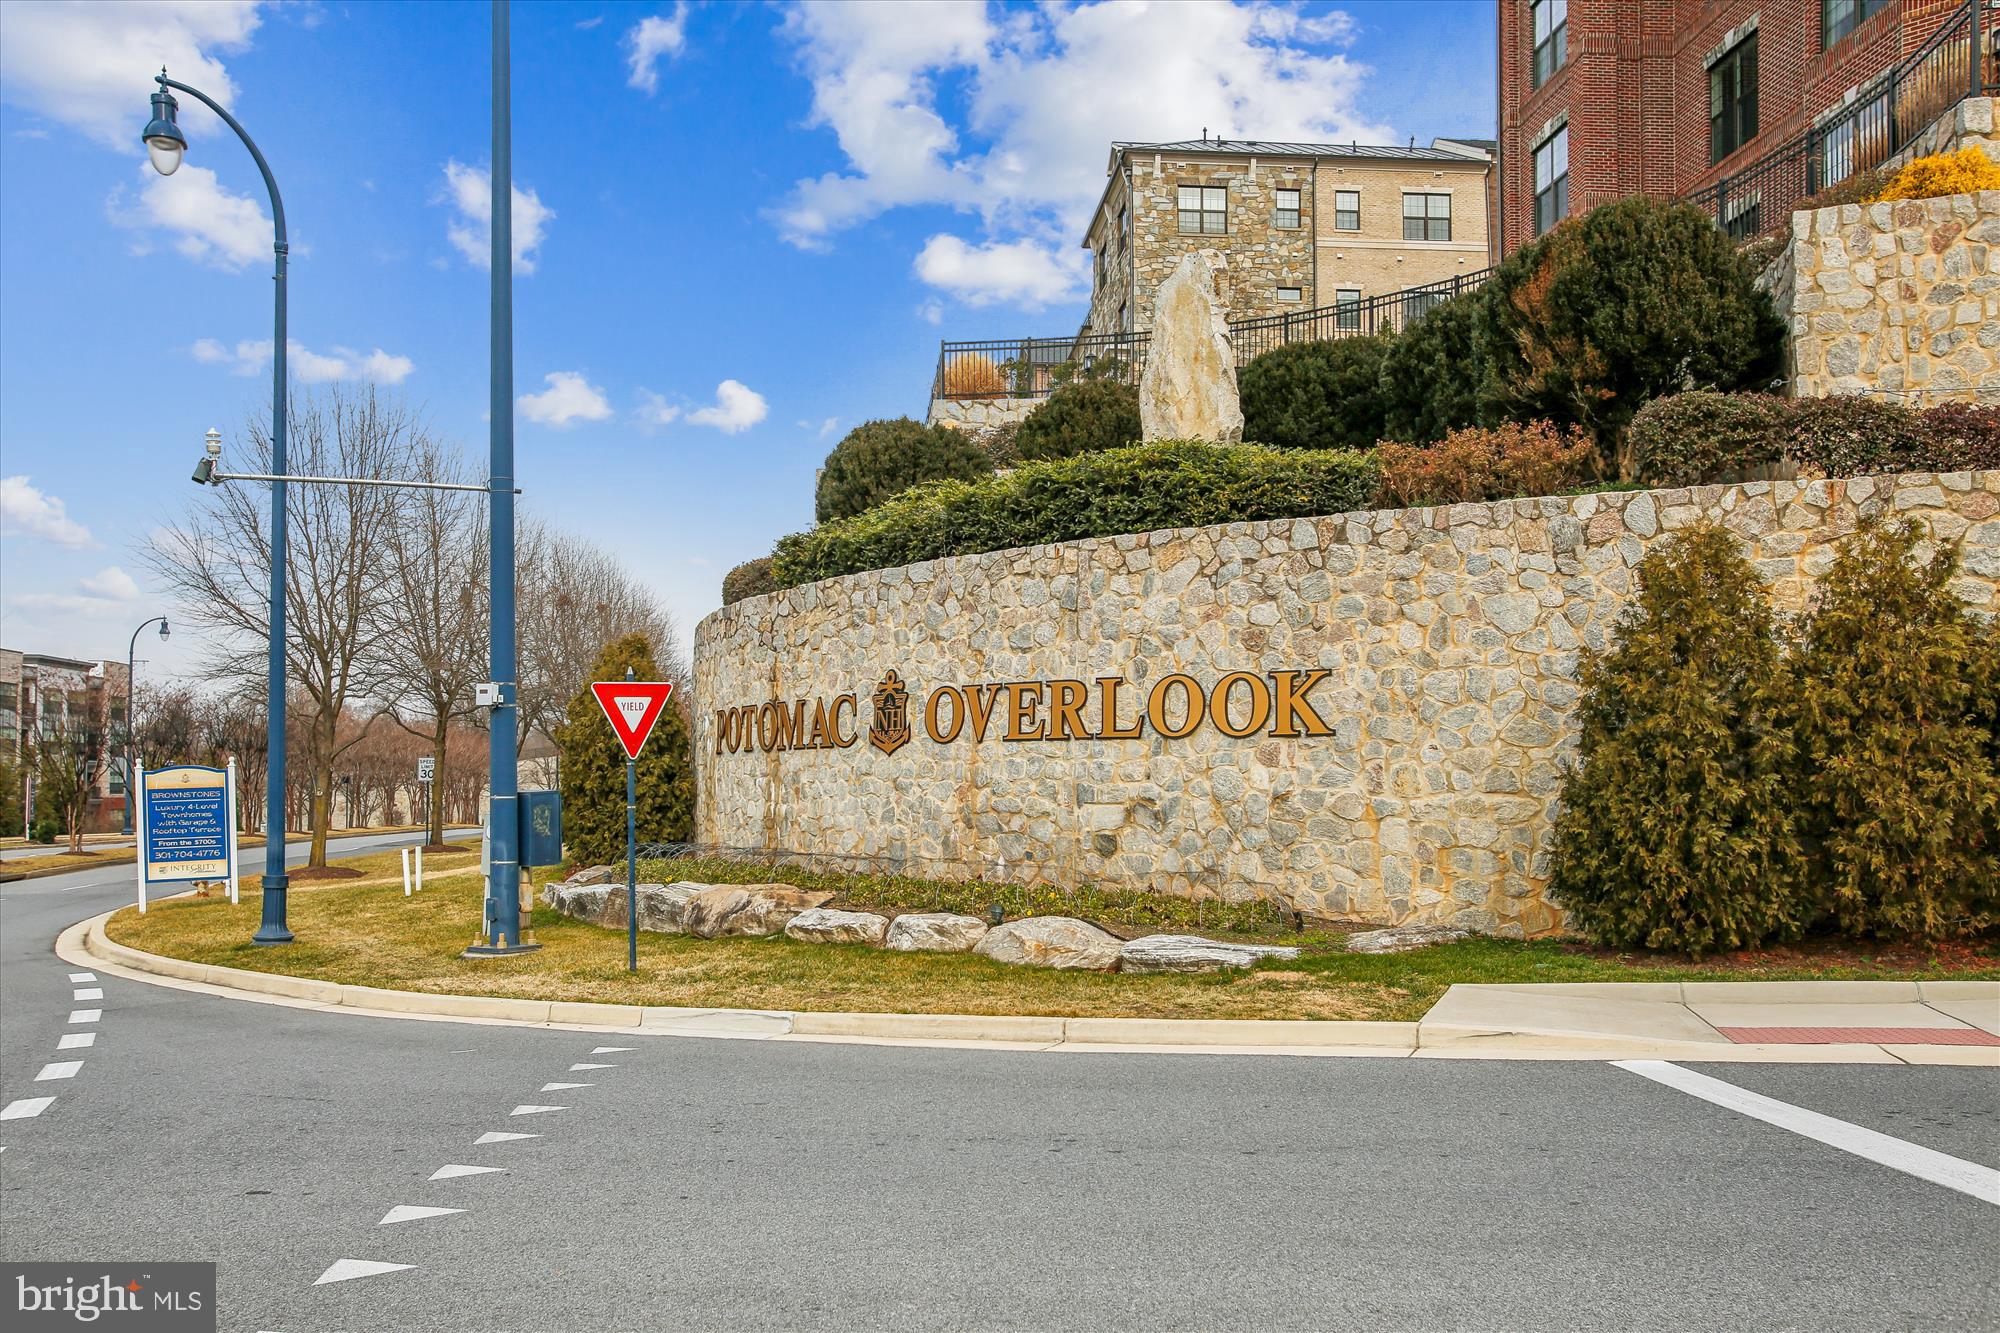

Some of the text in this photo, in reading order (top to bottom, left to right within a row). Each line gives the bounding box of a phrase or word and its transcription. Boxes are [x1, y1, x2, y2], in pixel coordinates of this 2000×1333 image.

[621, 702, 645, 711] YIELD
[716, 693, 858, 754] POTOMAC
[924, 668, 1337, 744] OVERLOOK
[420, 769, 434, 779] 30
[151, 791, 221, 799] BROWNSTONES
[178, 819, 208, 827] Garage
[155, 849, 221, 860] 301-704-4776
[170, 863, 217, 872] INTEGRITY
